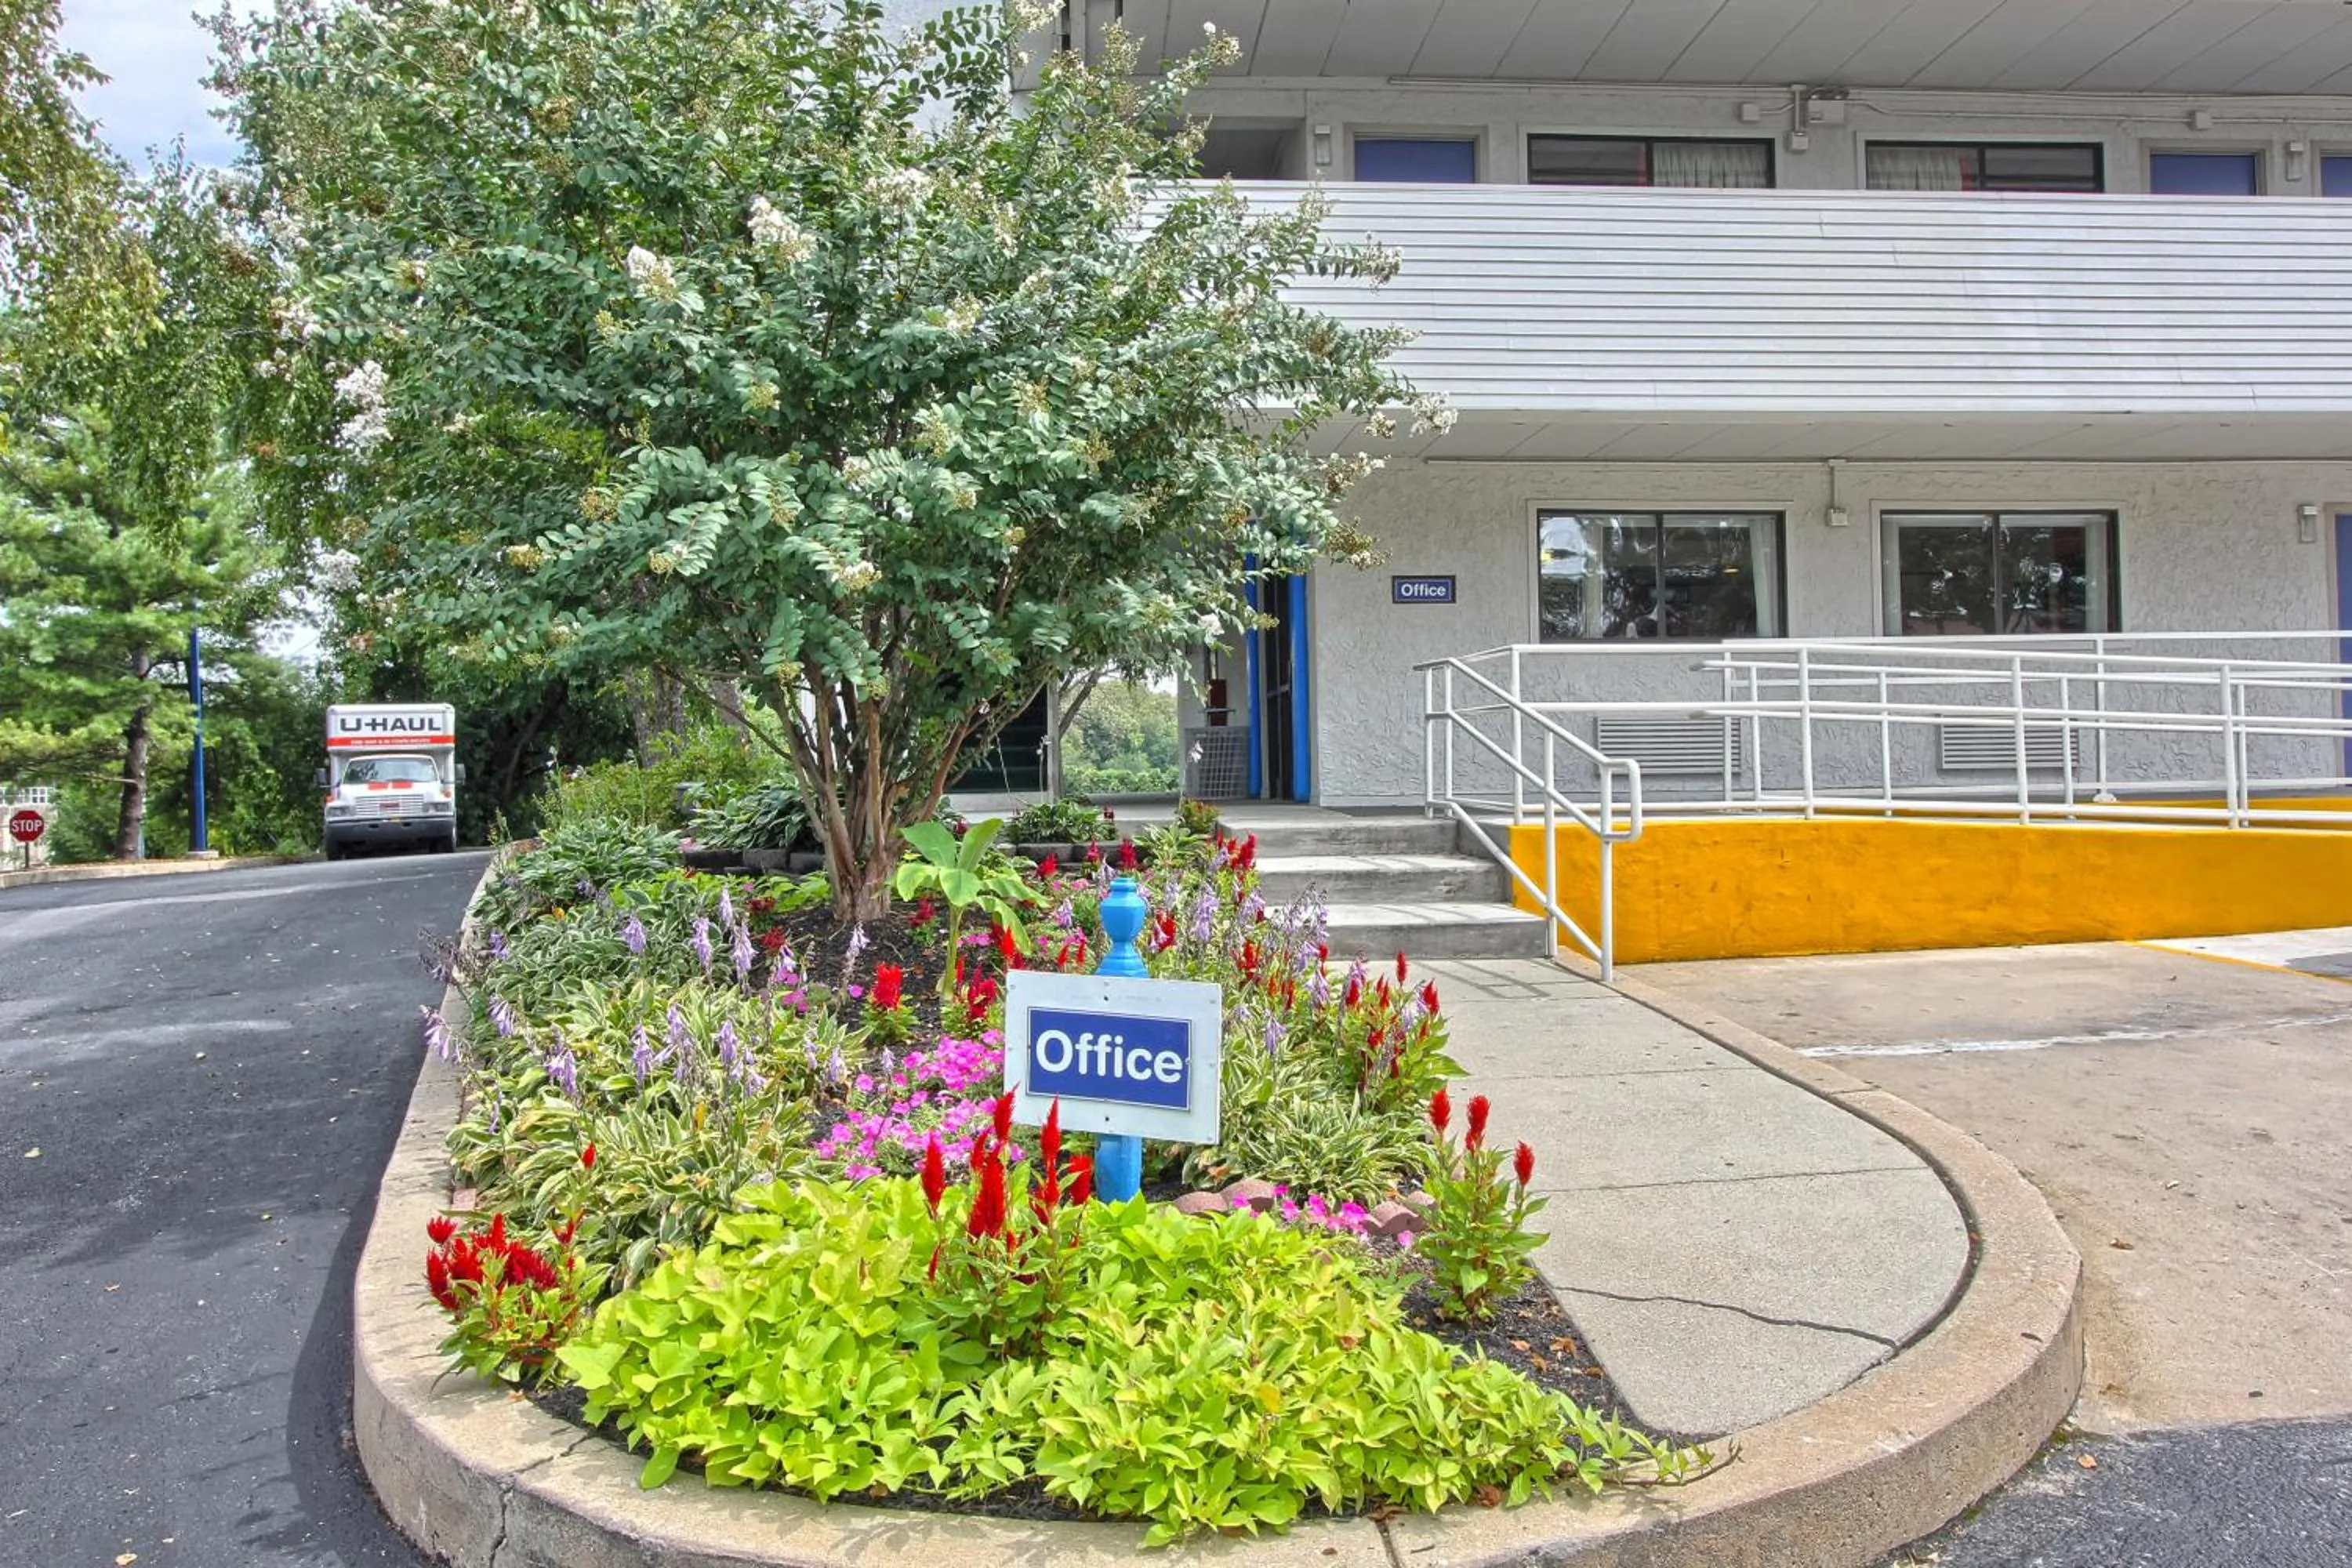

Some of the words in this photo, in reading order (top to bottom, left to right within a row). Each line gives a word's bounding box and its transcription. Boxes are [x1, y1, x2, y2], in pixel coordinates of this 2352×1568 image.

[1401, 583, 1446, 597] Office
[340, 717, 441, 731] U-HAUL
[12, 819, 42, 832] STOP
[1036, 1029, 1183, 1083] Office
